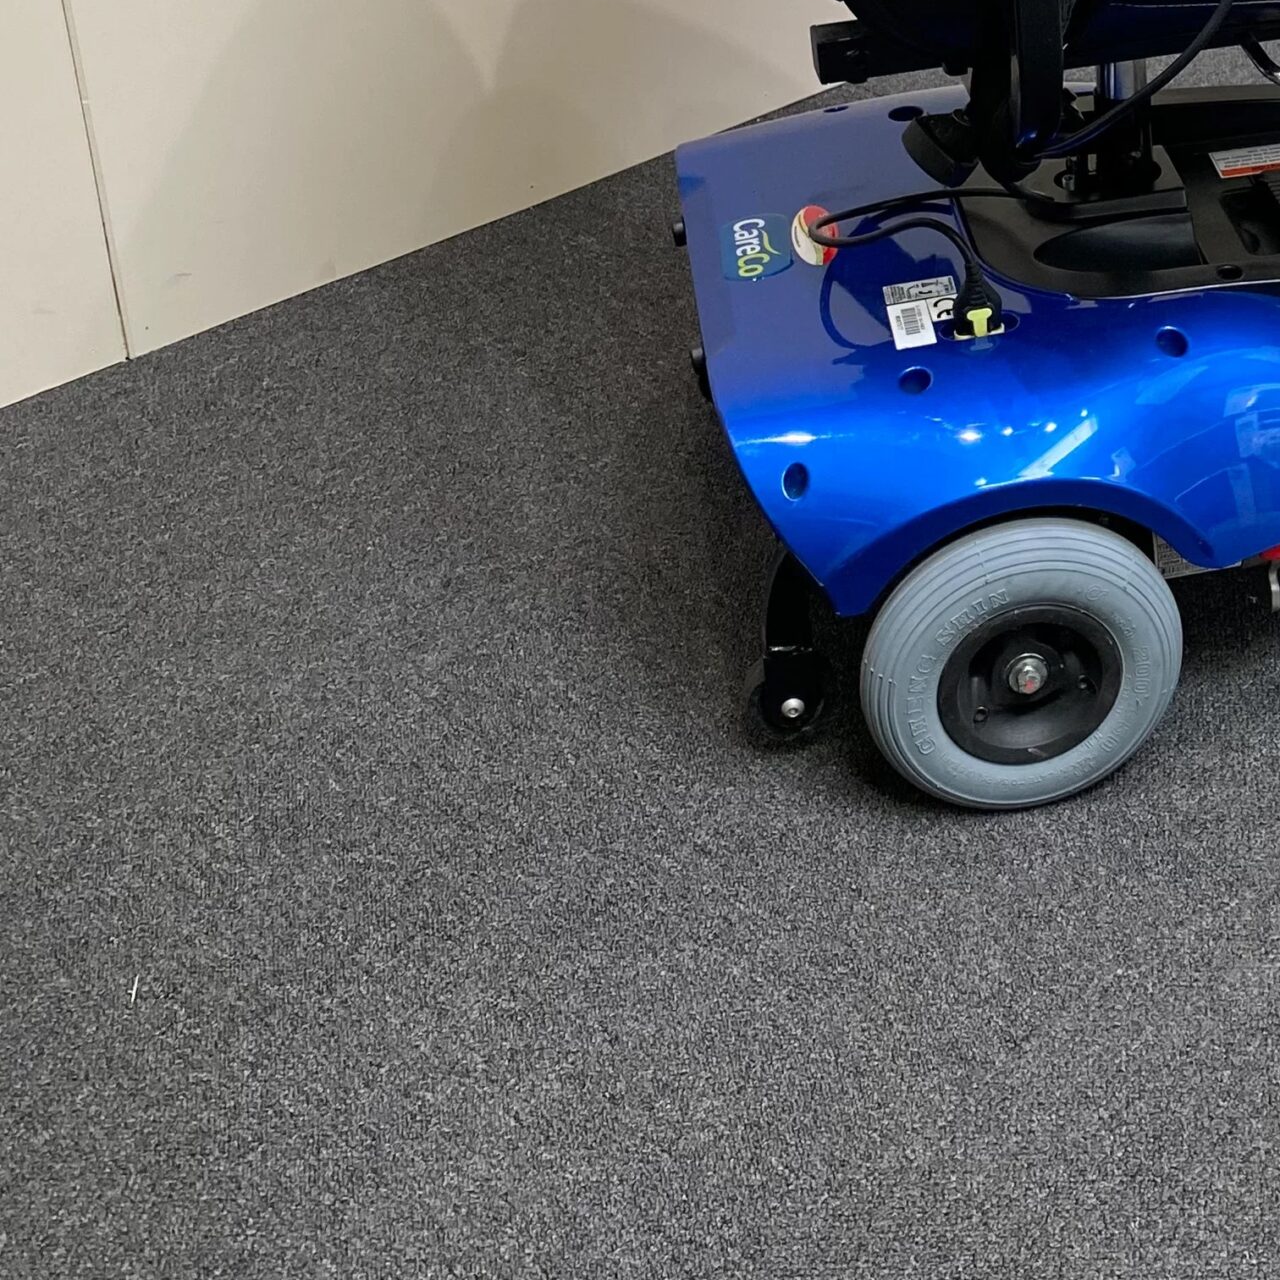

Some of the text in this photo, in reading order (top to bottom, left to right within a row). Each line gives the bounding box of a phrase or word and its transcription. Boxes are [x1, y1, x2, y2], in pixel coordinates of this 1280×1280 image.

[733, 218, 770, 276] CareCo
[906, 588, 1010, 755] CHENG SHIN
